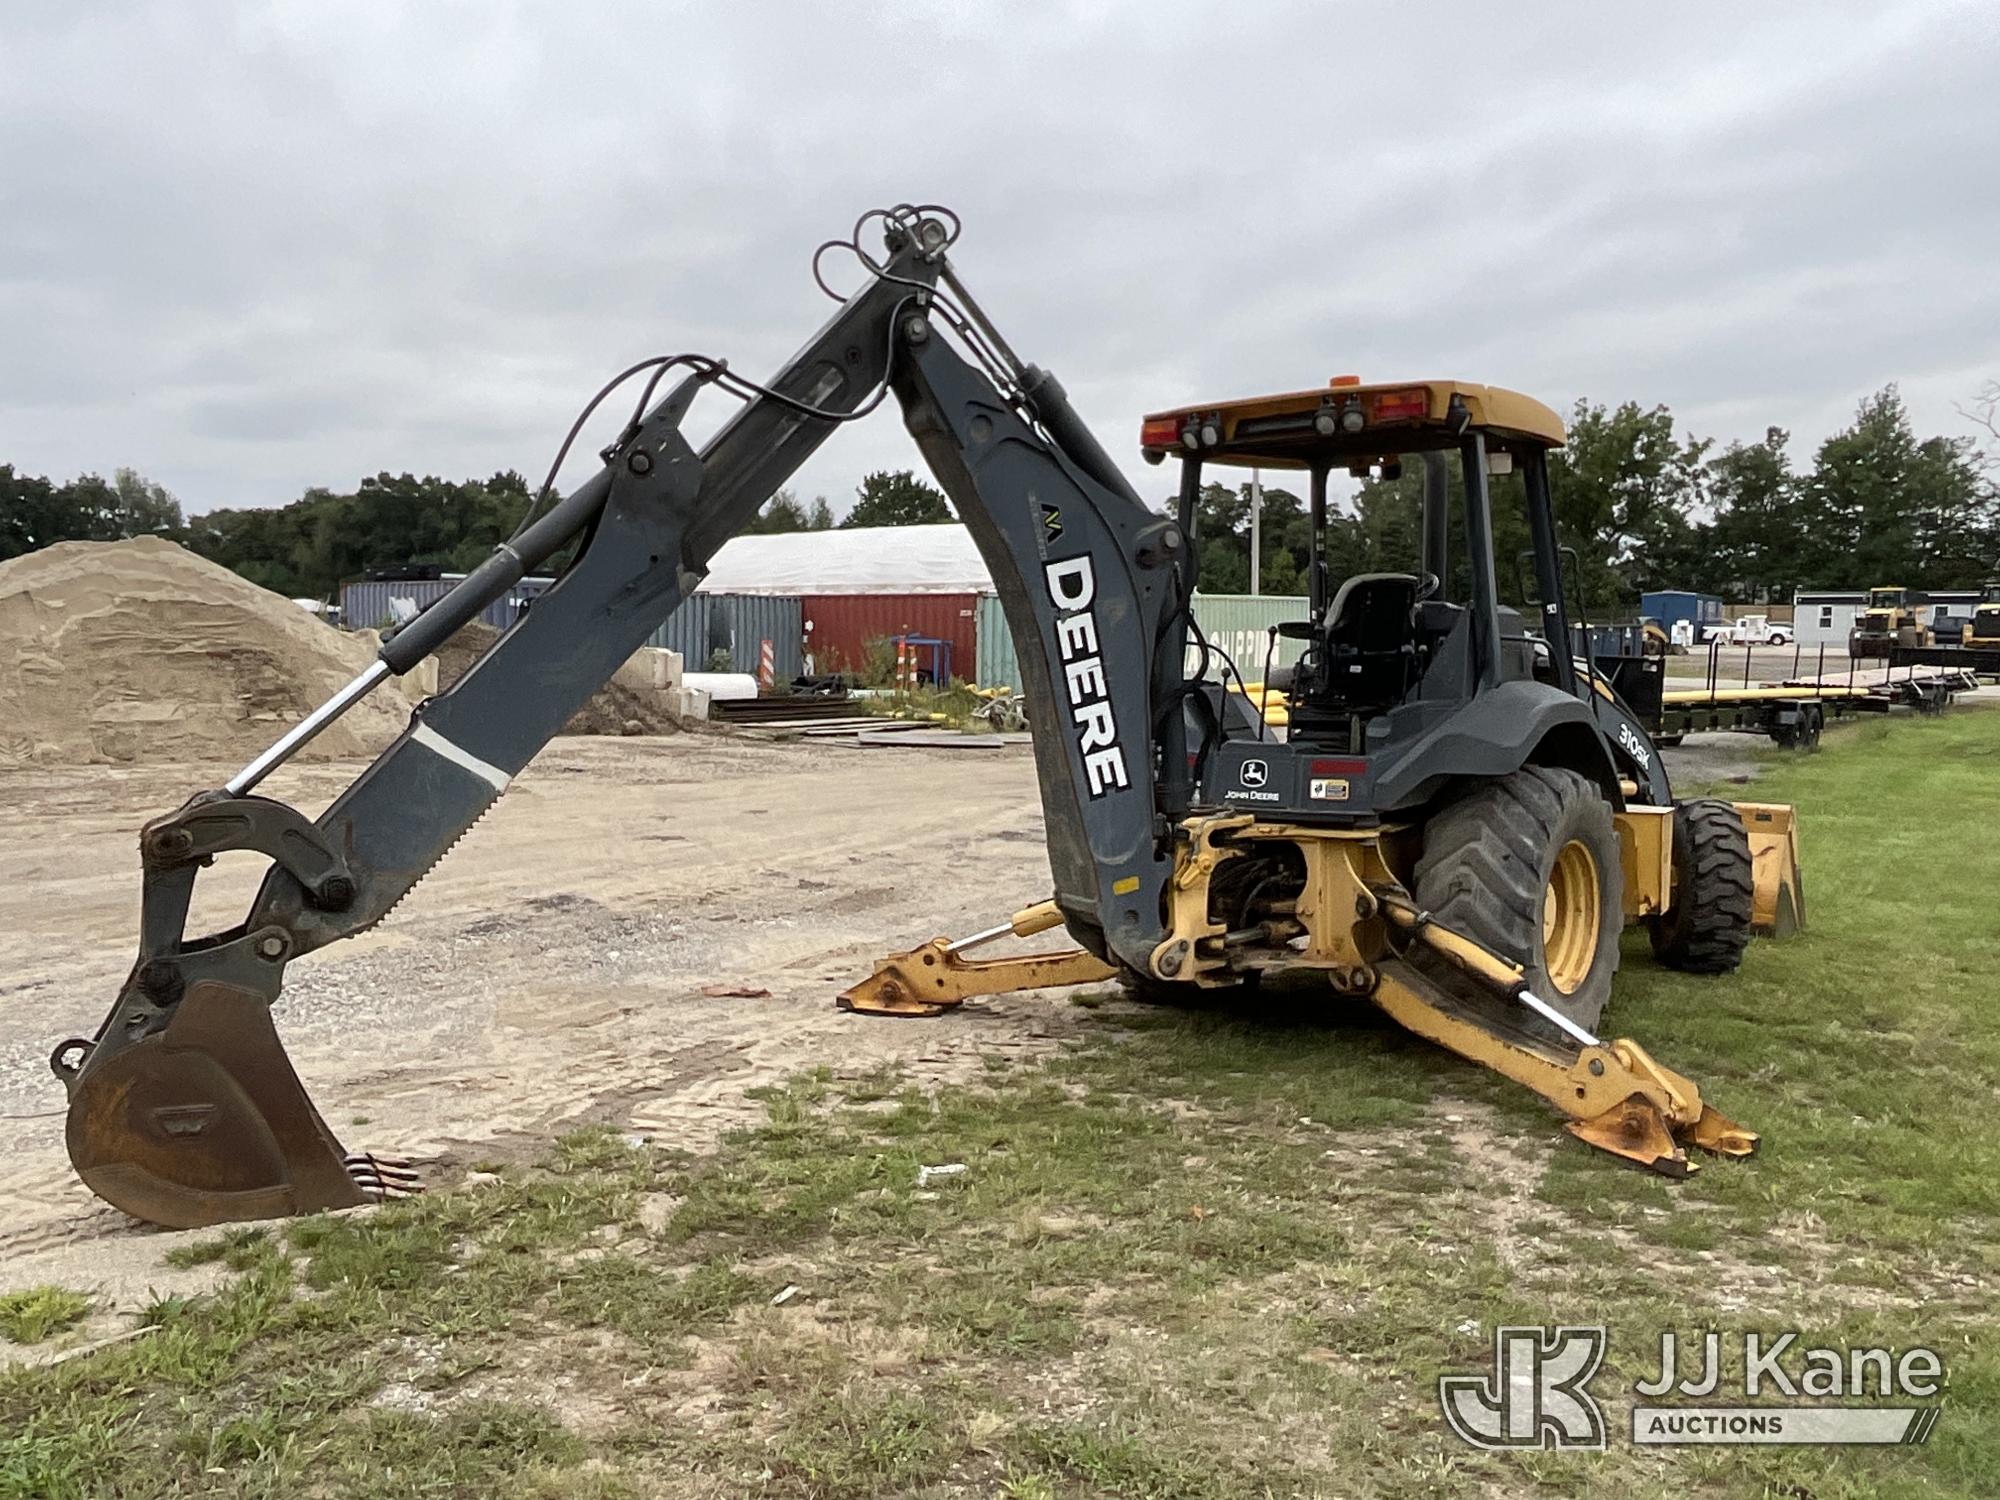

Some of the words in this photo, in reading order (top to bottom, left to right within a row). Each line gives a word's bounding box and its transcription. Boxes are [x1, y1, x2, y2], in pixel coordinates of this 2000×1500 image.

[1044, 554, 1130, 797] DEERE
[1618, 723, 1651, 770] 310SK
[1225, 790, 1249, 799] JOHN
[1250, 791, 1279, 801] DEERE
